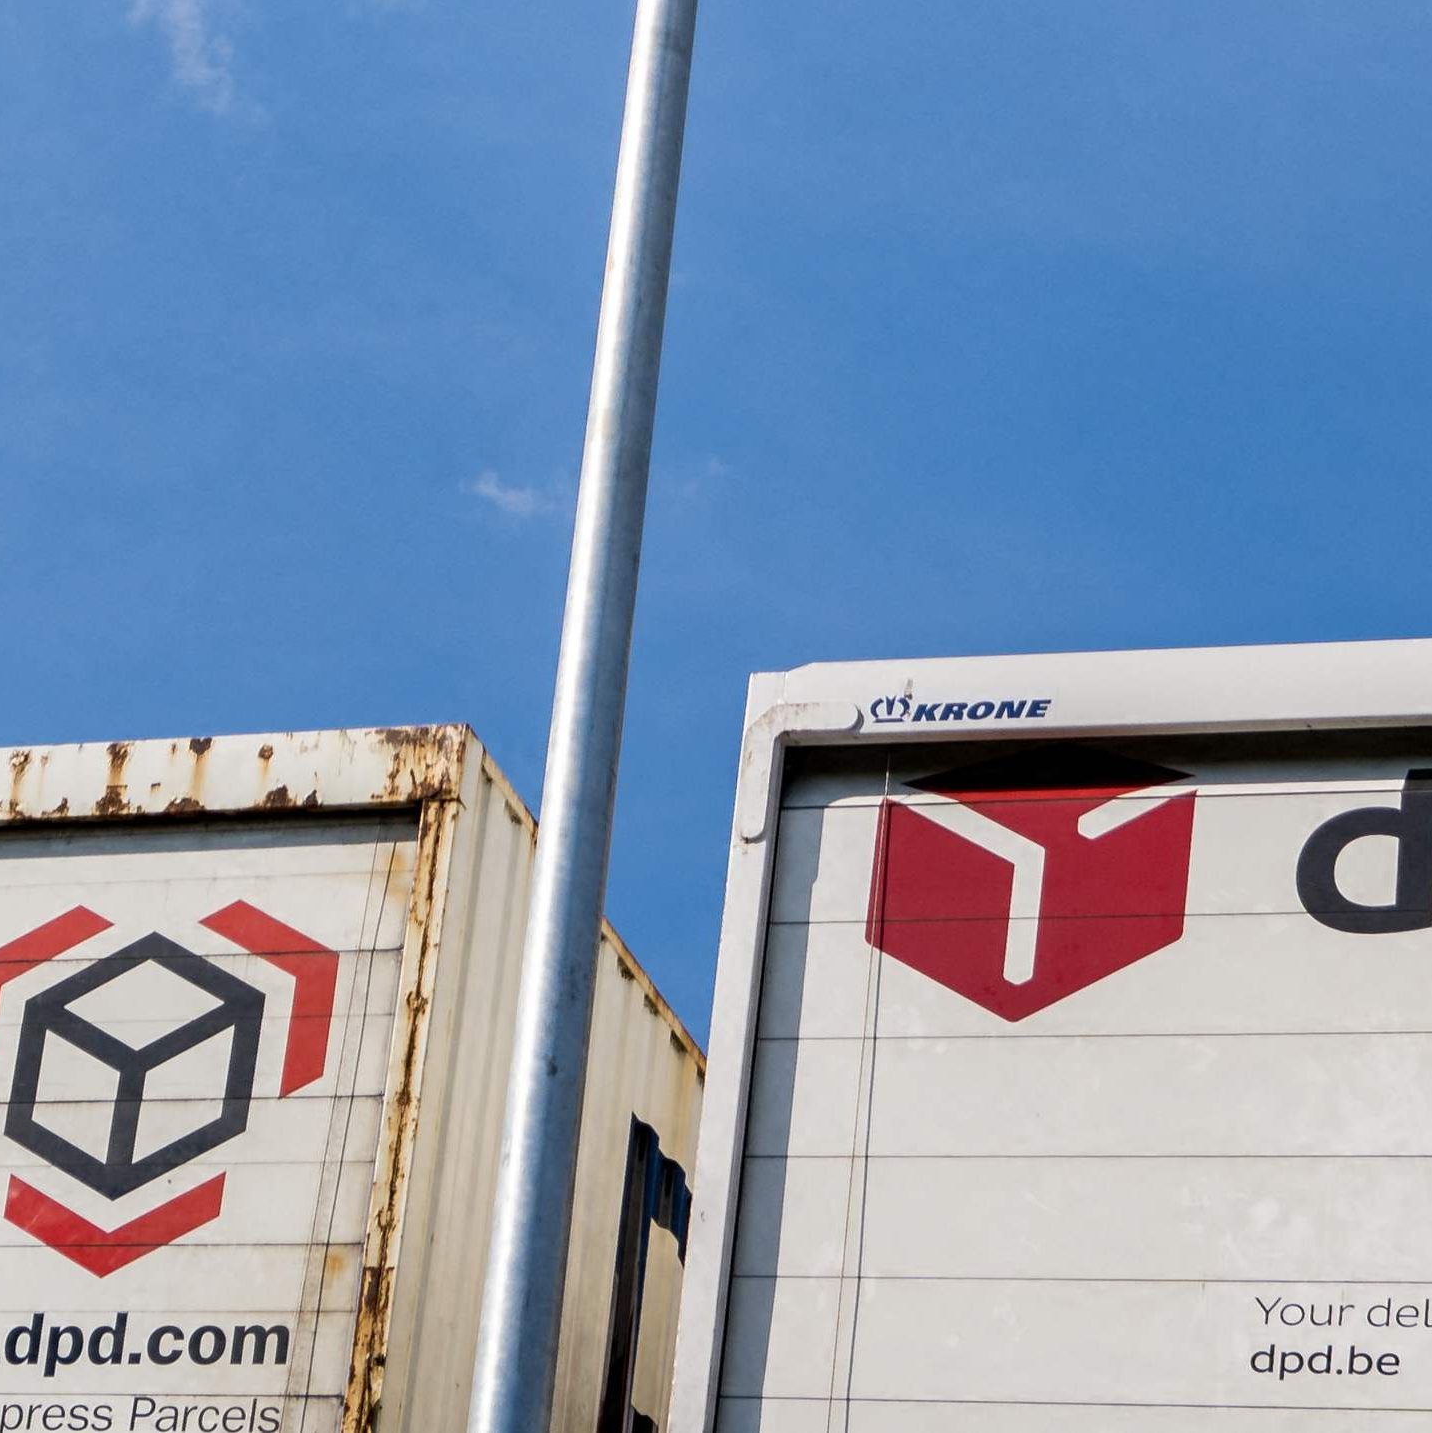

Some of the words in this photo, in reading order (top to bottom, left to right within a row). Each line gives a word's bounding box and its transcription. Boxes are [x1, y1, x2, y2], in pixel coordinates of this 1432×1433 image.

[911, 698, 1052, 723] KRONE
[1255, 1296, 1355, 1328] Your
[1249, 1343, 1401, 1380] dpd.be
[129, 1395, 281, 1433] Parcels
